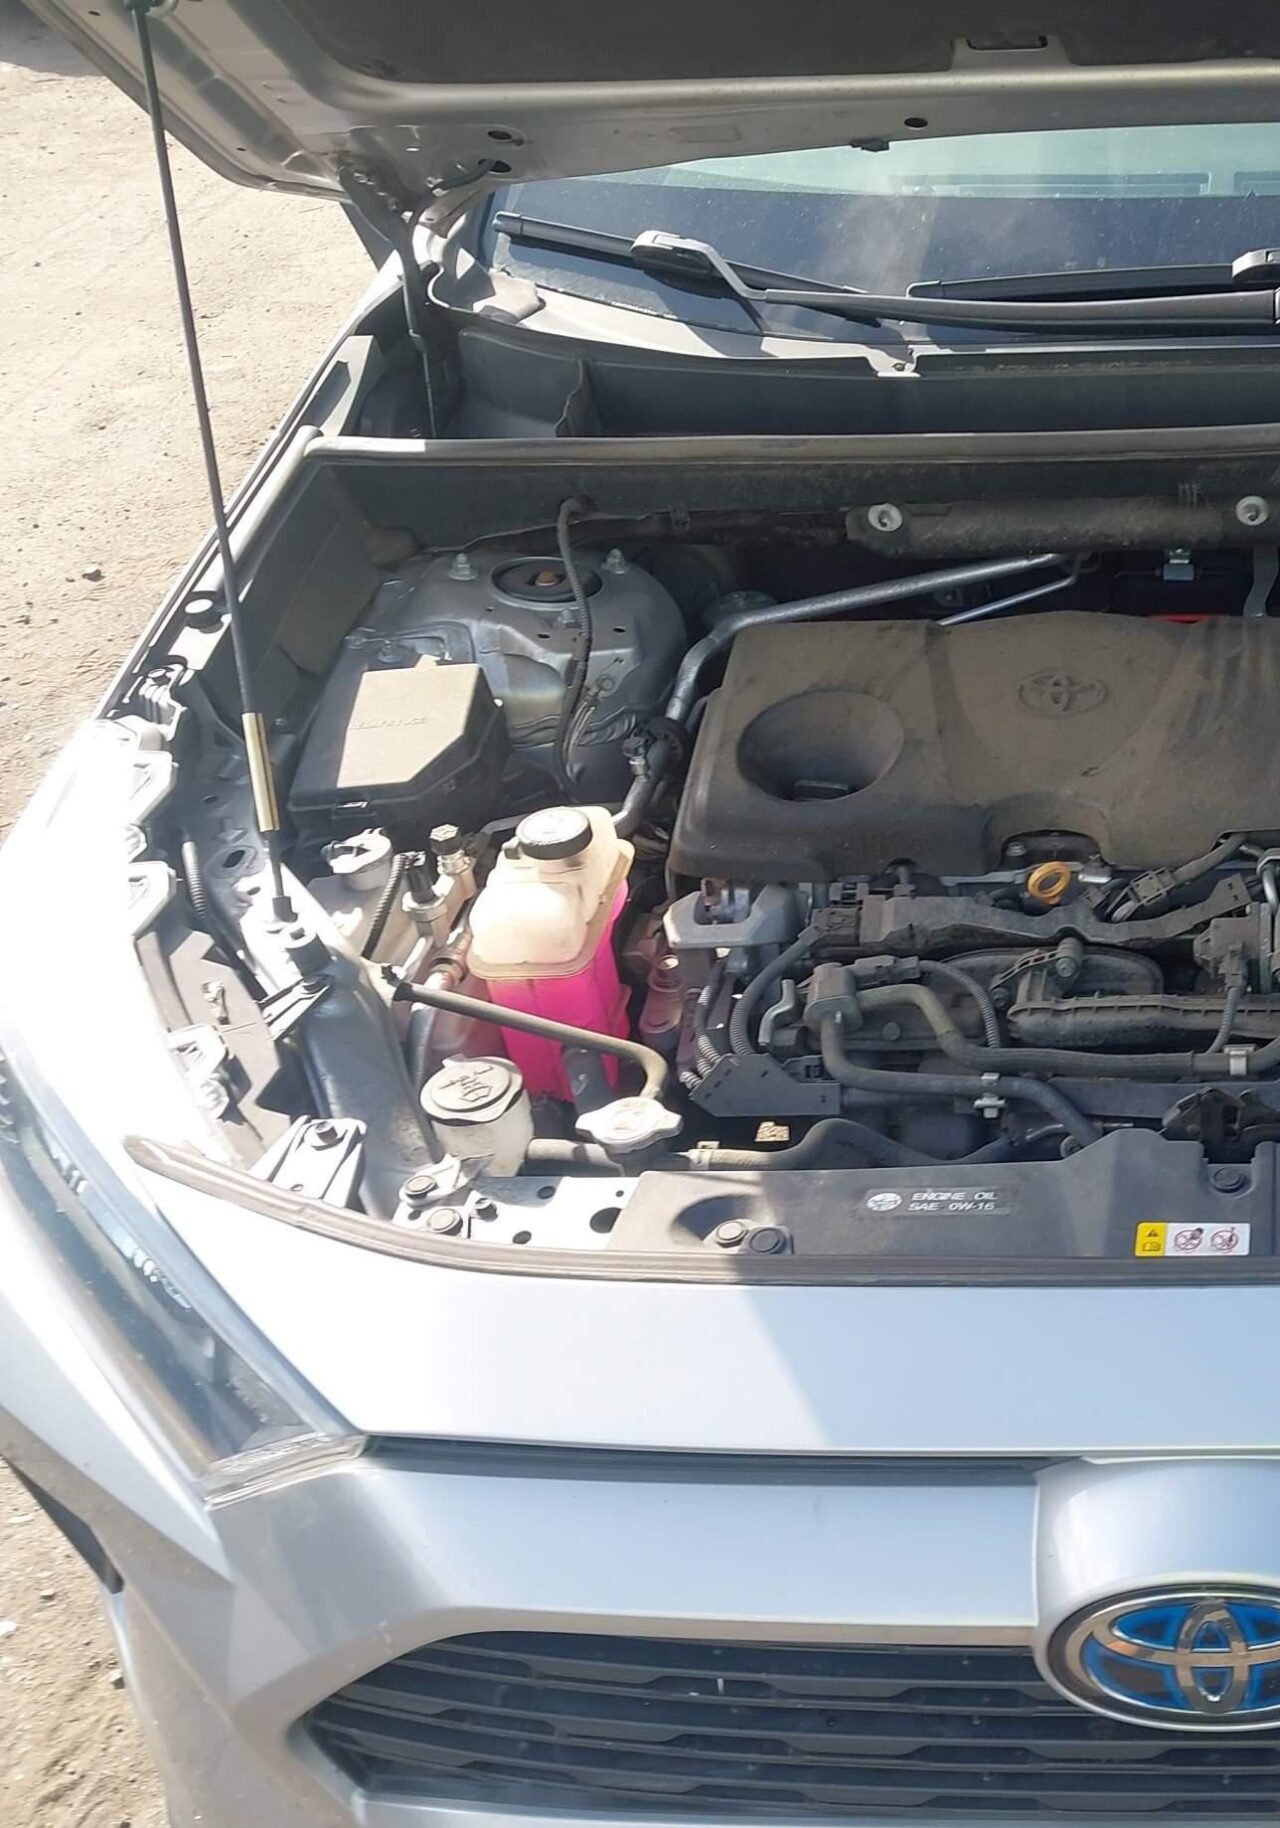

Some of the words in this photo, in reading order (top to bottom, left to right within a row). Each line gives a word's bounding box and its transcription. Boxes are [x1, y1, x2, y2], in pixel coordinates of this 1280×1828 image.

[911, 1191, 967, 1201] ENGINE
[973, 1191, 998, 1200] OIL
[907, 1202, 940, 1211] SAE
[948, 1202, 995, 1211] 0W-16
